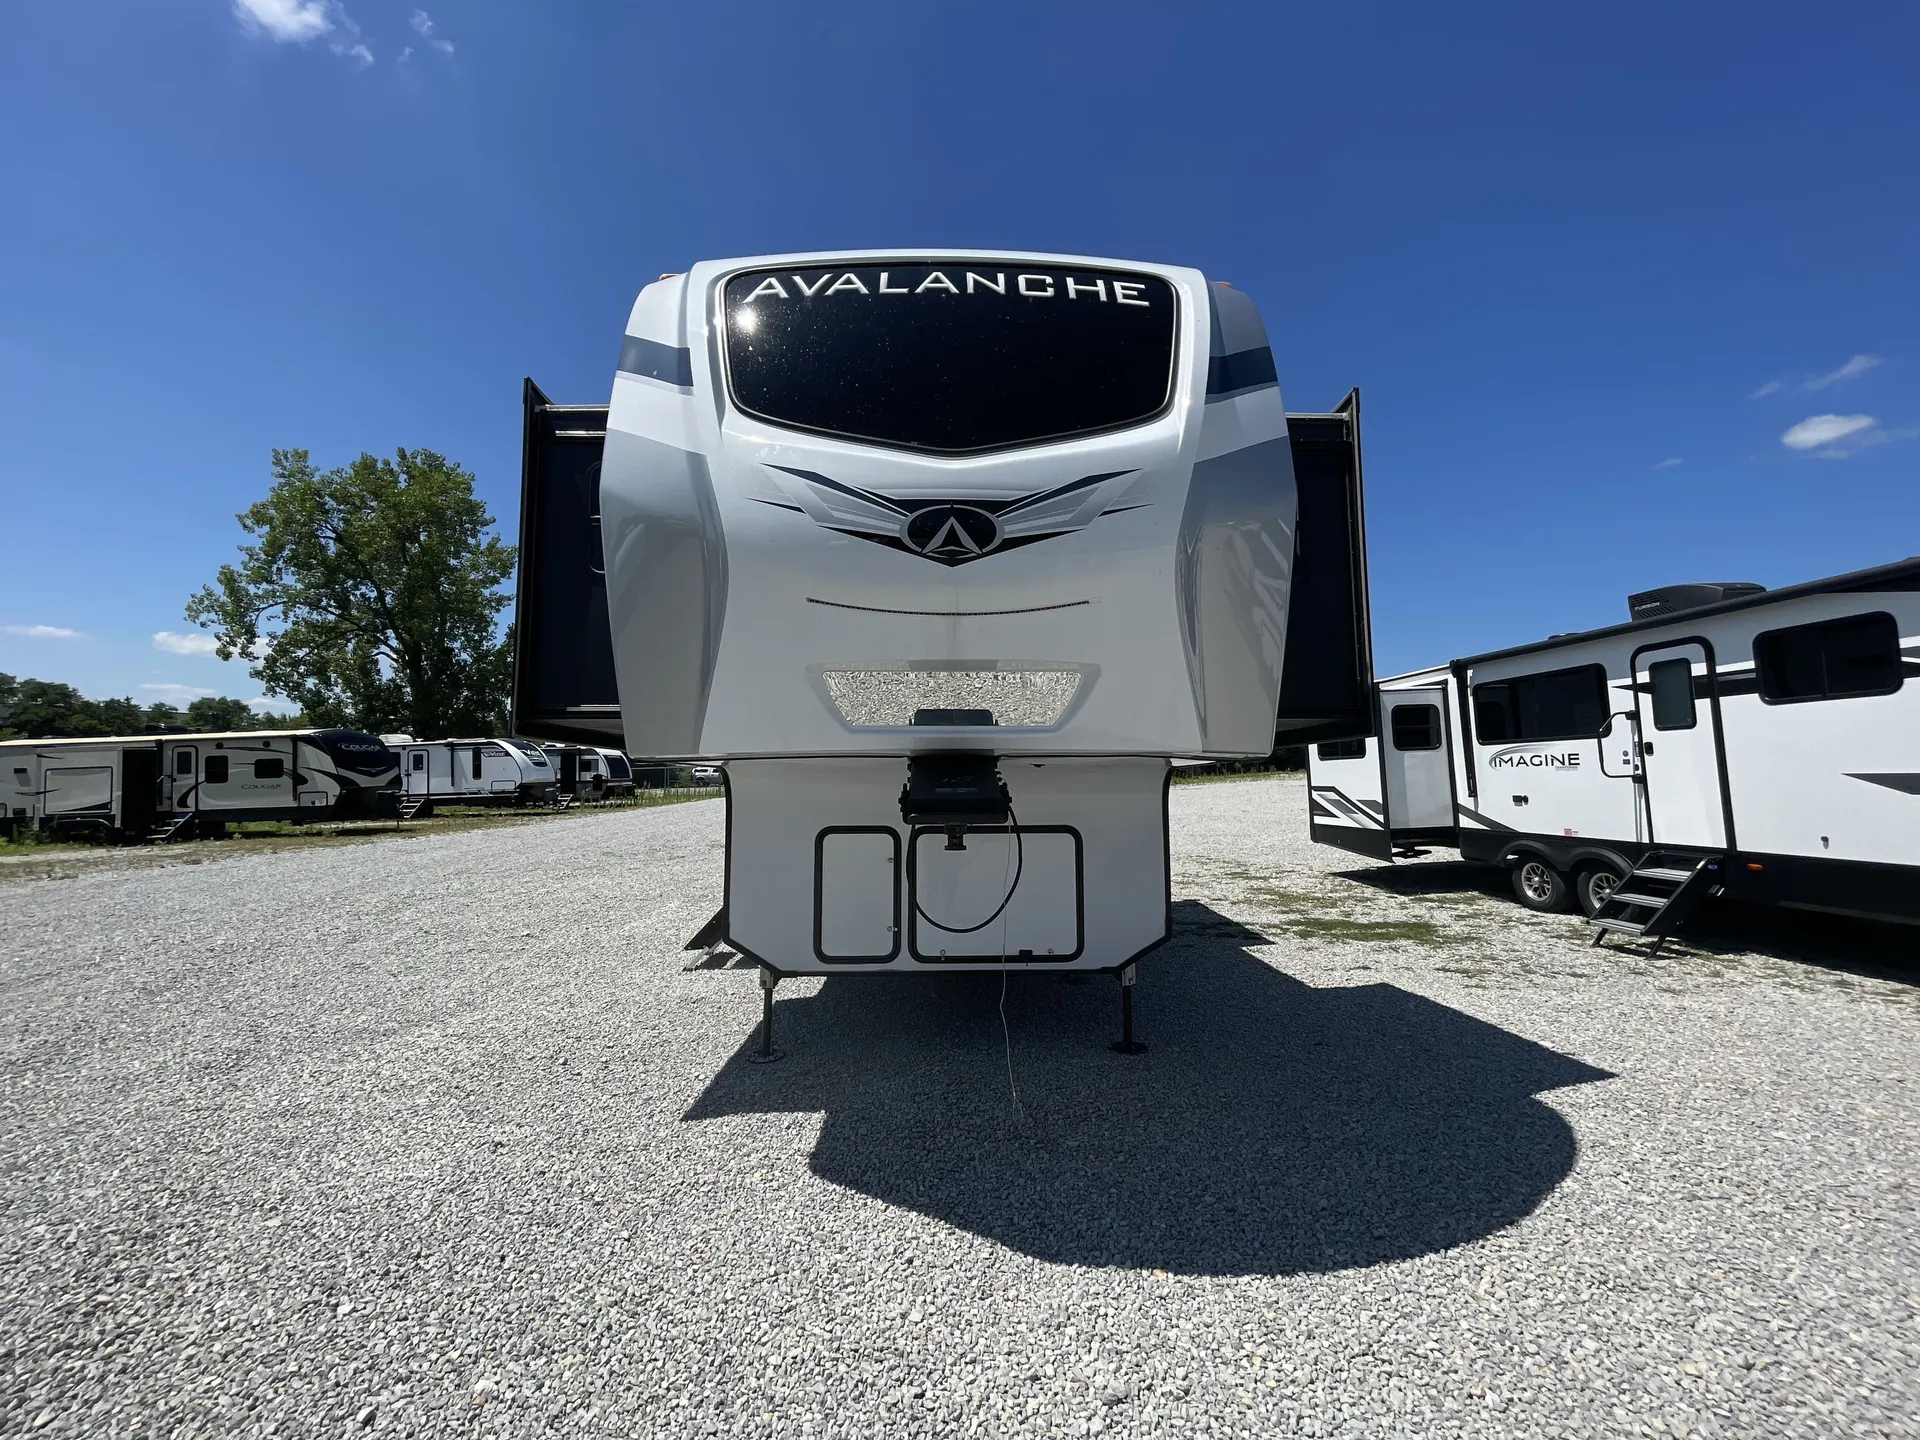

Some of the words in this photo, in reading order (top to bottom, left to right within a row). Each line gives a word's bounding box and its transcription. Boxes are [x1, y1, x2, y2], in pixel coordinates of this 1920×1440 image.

[743, 271, 1151, 307] AVALANCHE
[341, 743, 382, 751] COUGAR
[1493, 753, 1580, 767] IMAGINE
